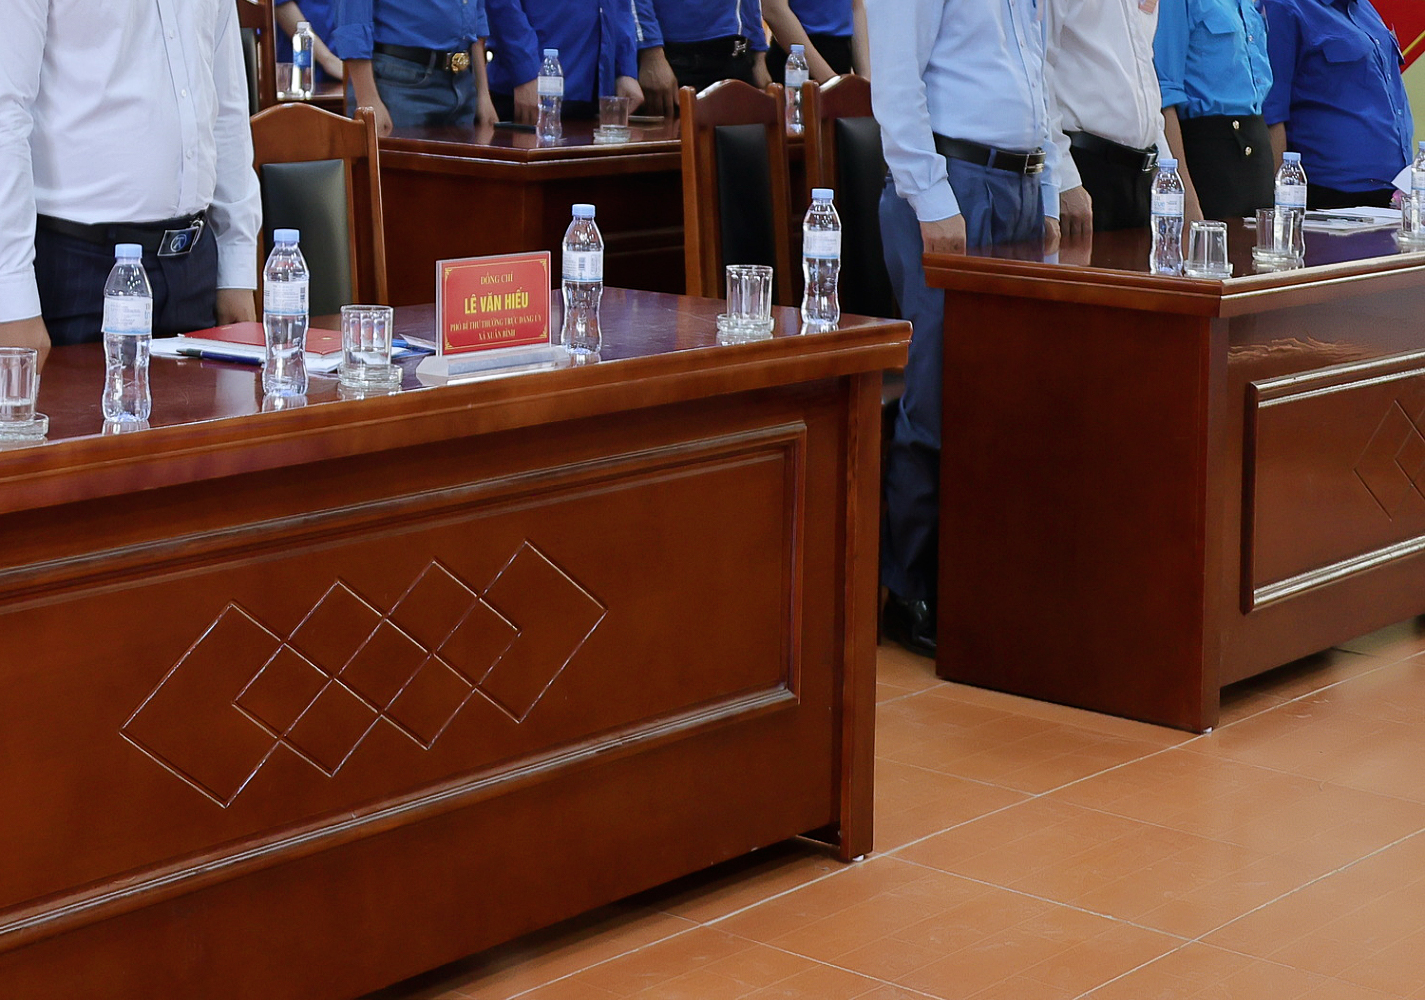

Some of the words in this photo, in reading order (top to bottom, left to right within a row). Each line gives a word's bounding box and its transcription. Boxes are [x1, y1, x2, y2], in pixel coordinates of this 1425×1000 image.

[464, 294, 477, 314] LÊ
[480, 292, 502, 313] VĂN
[504, 286, 529, 310] HIẾU
